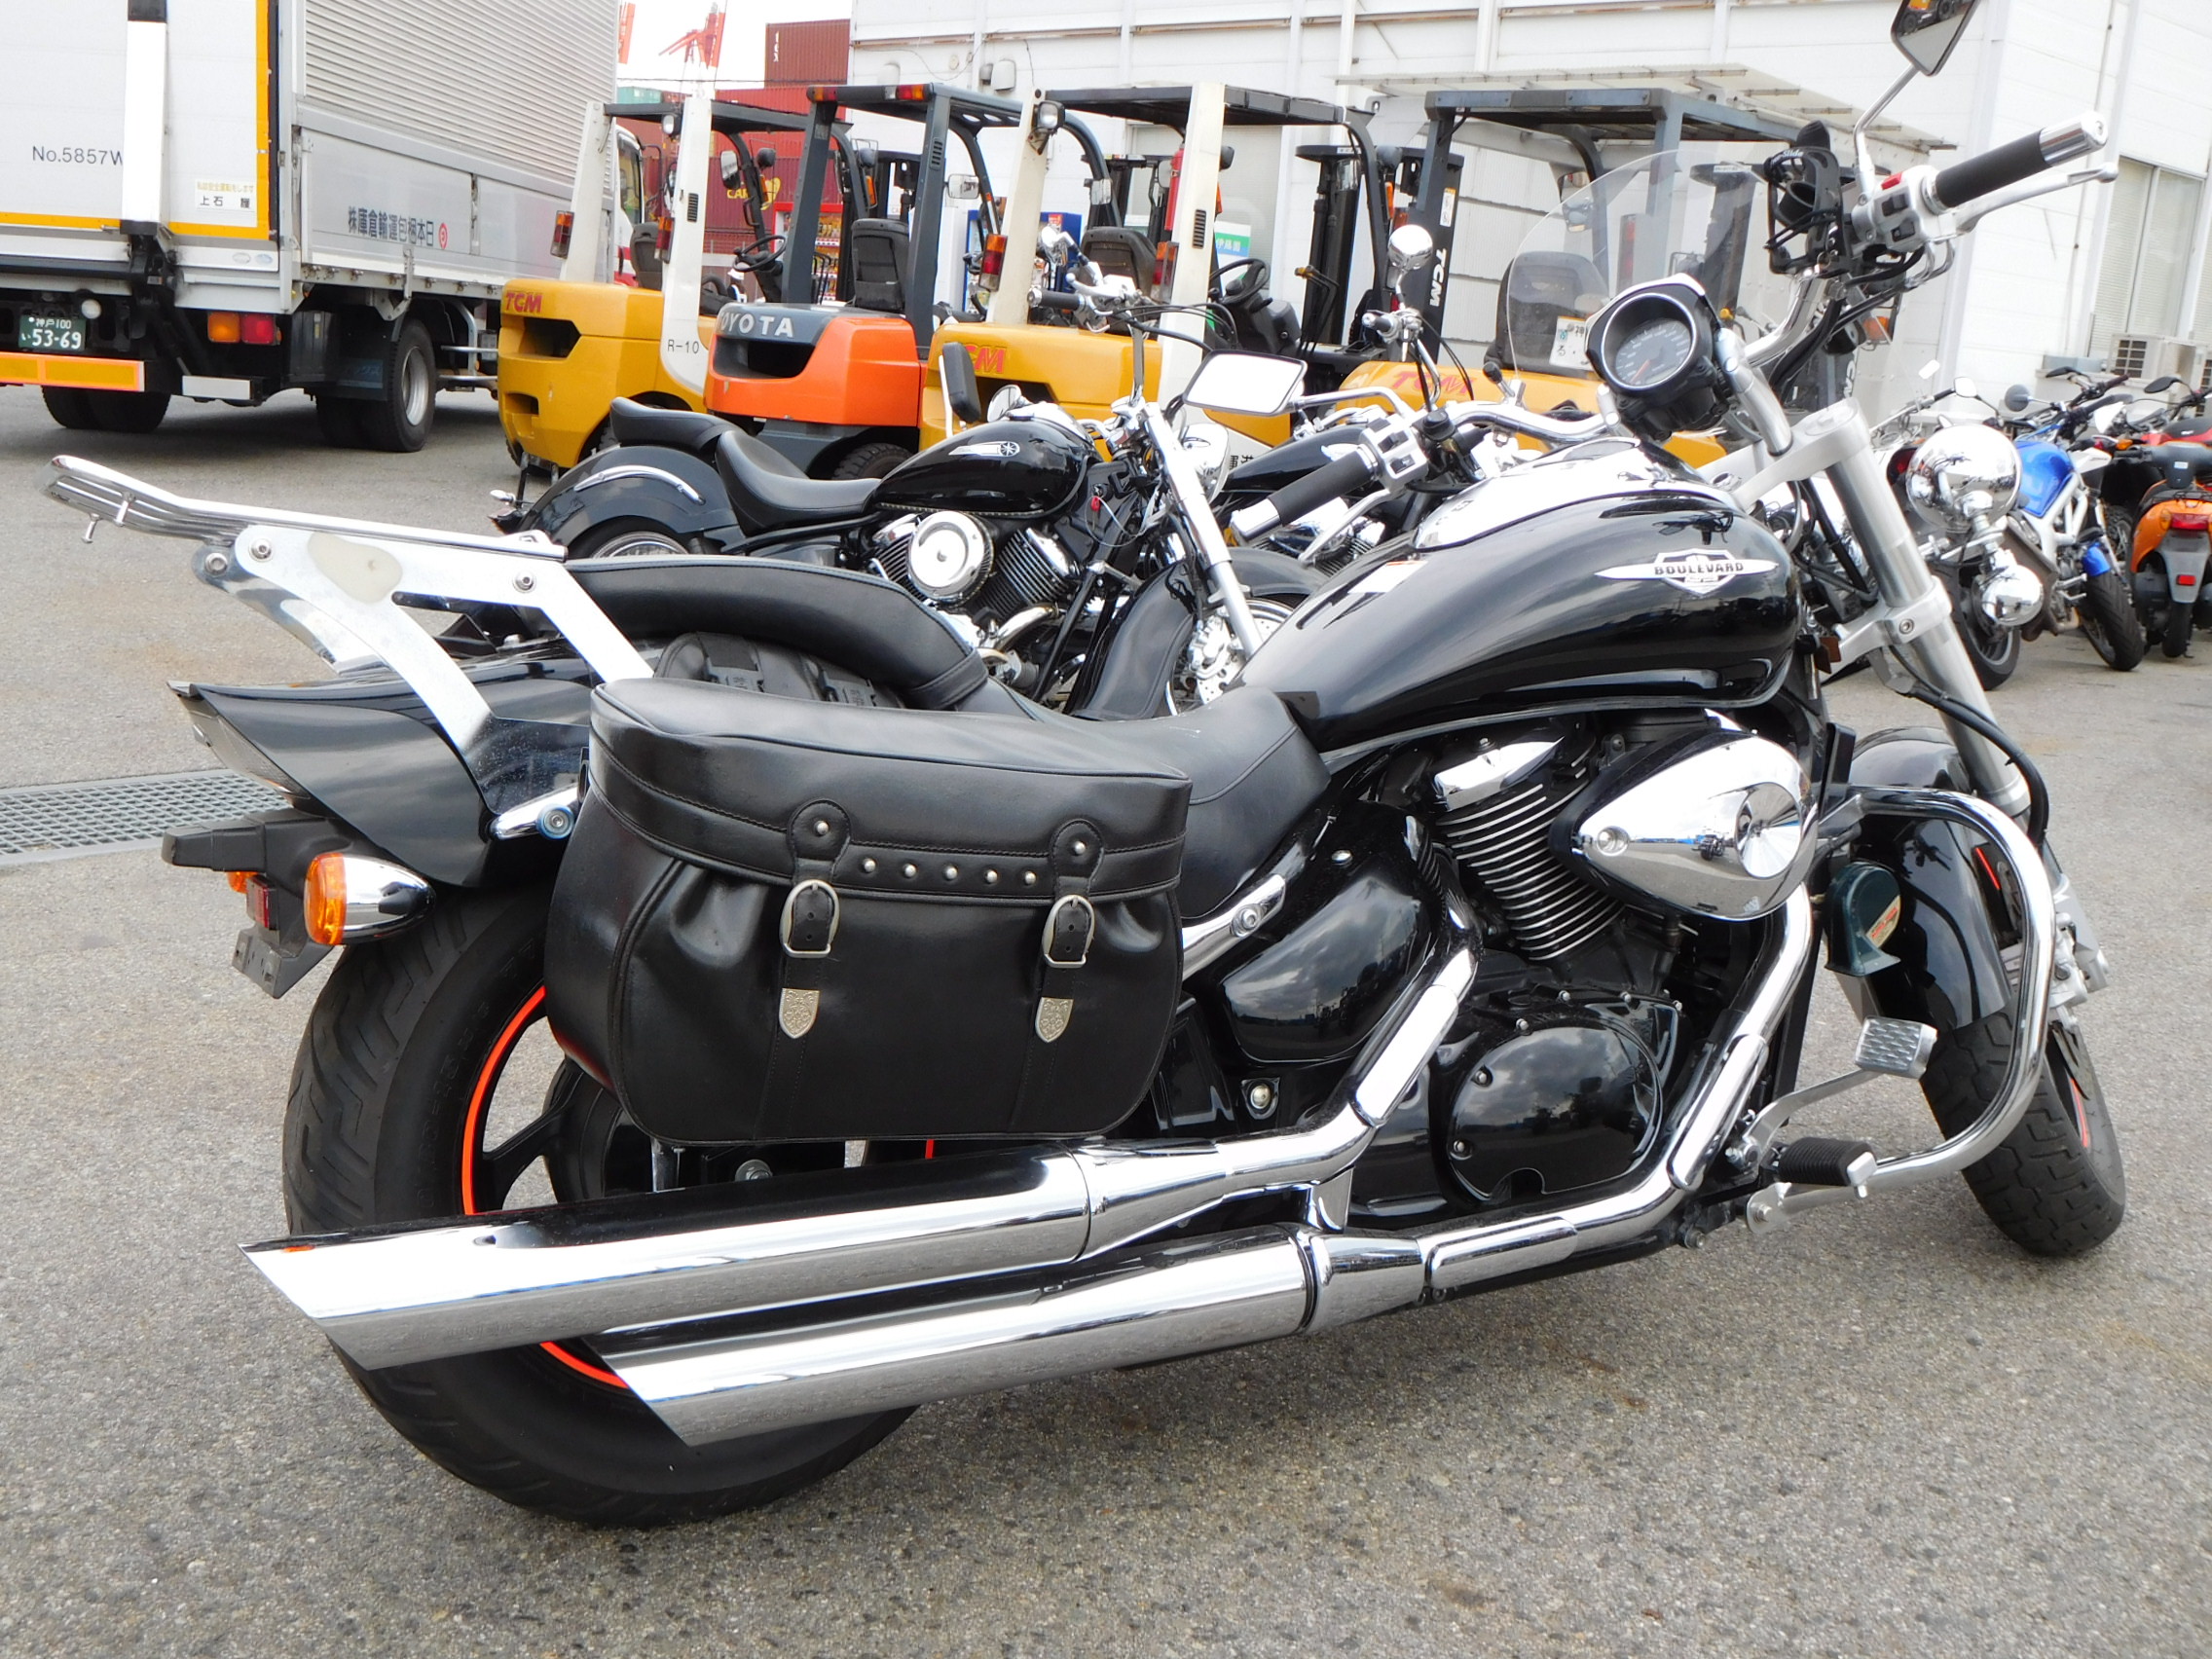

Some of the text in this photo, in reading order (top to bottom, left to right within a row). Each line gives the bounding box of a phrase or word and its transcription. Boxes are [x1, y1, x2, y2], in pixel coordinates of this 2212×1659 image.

[1429, 247, 1448, 308] TCM
[505, 291, 543, 313] TCM
[32, 328, 82, 350] 53-69
[667, 339, 700, 354] R-10
[1654, 563, 1745, 576] BOULEVARD
